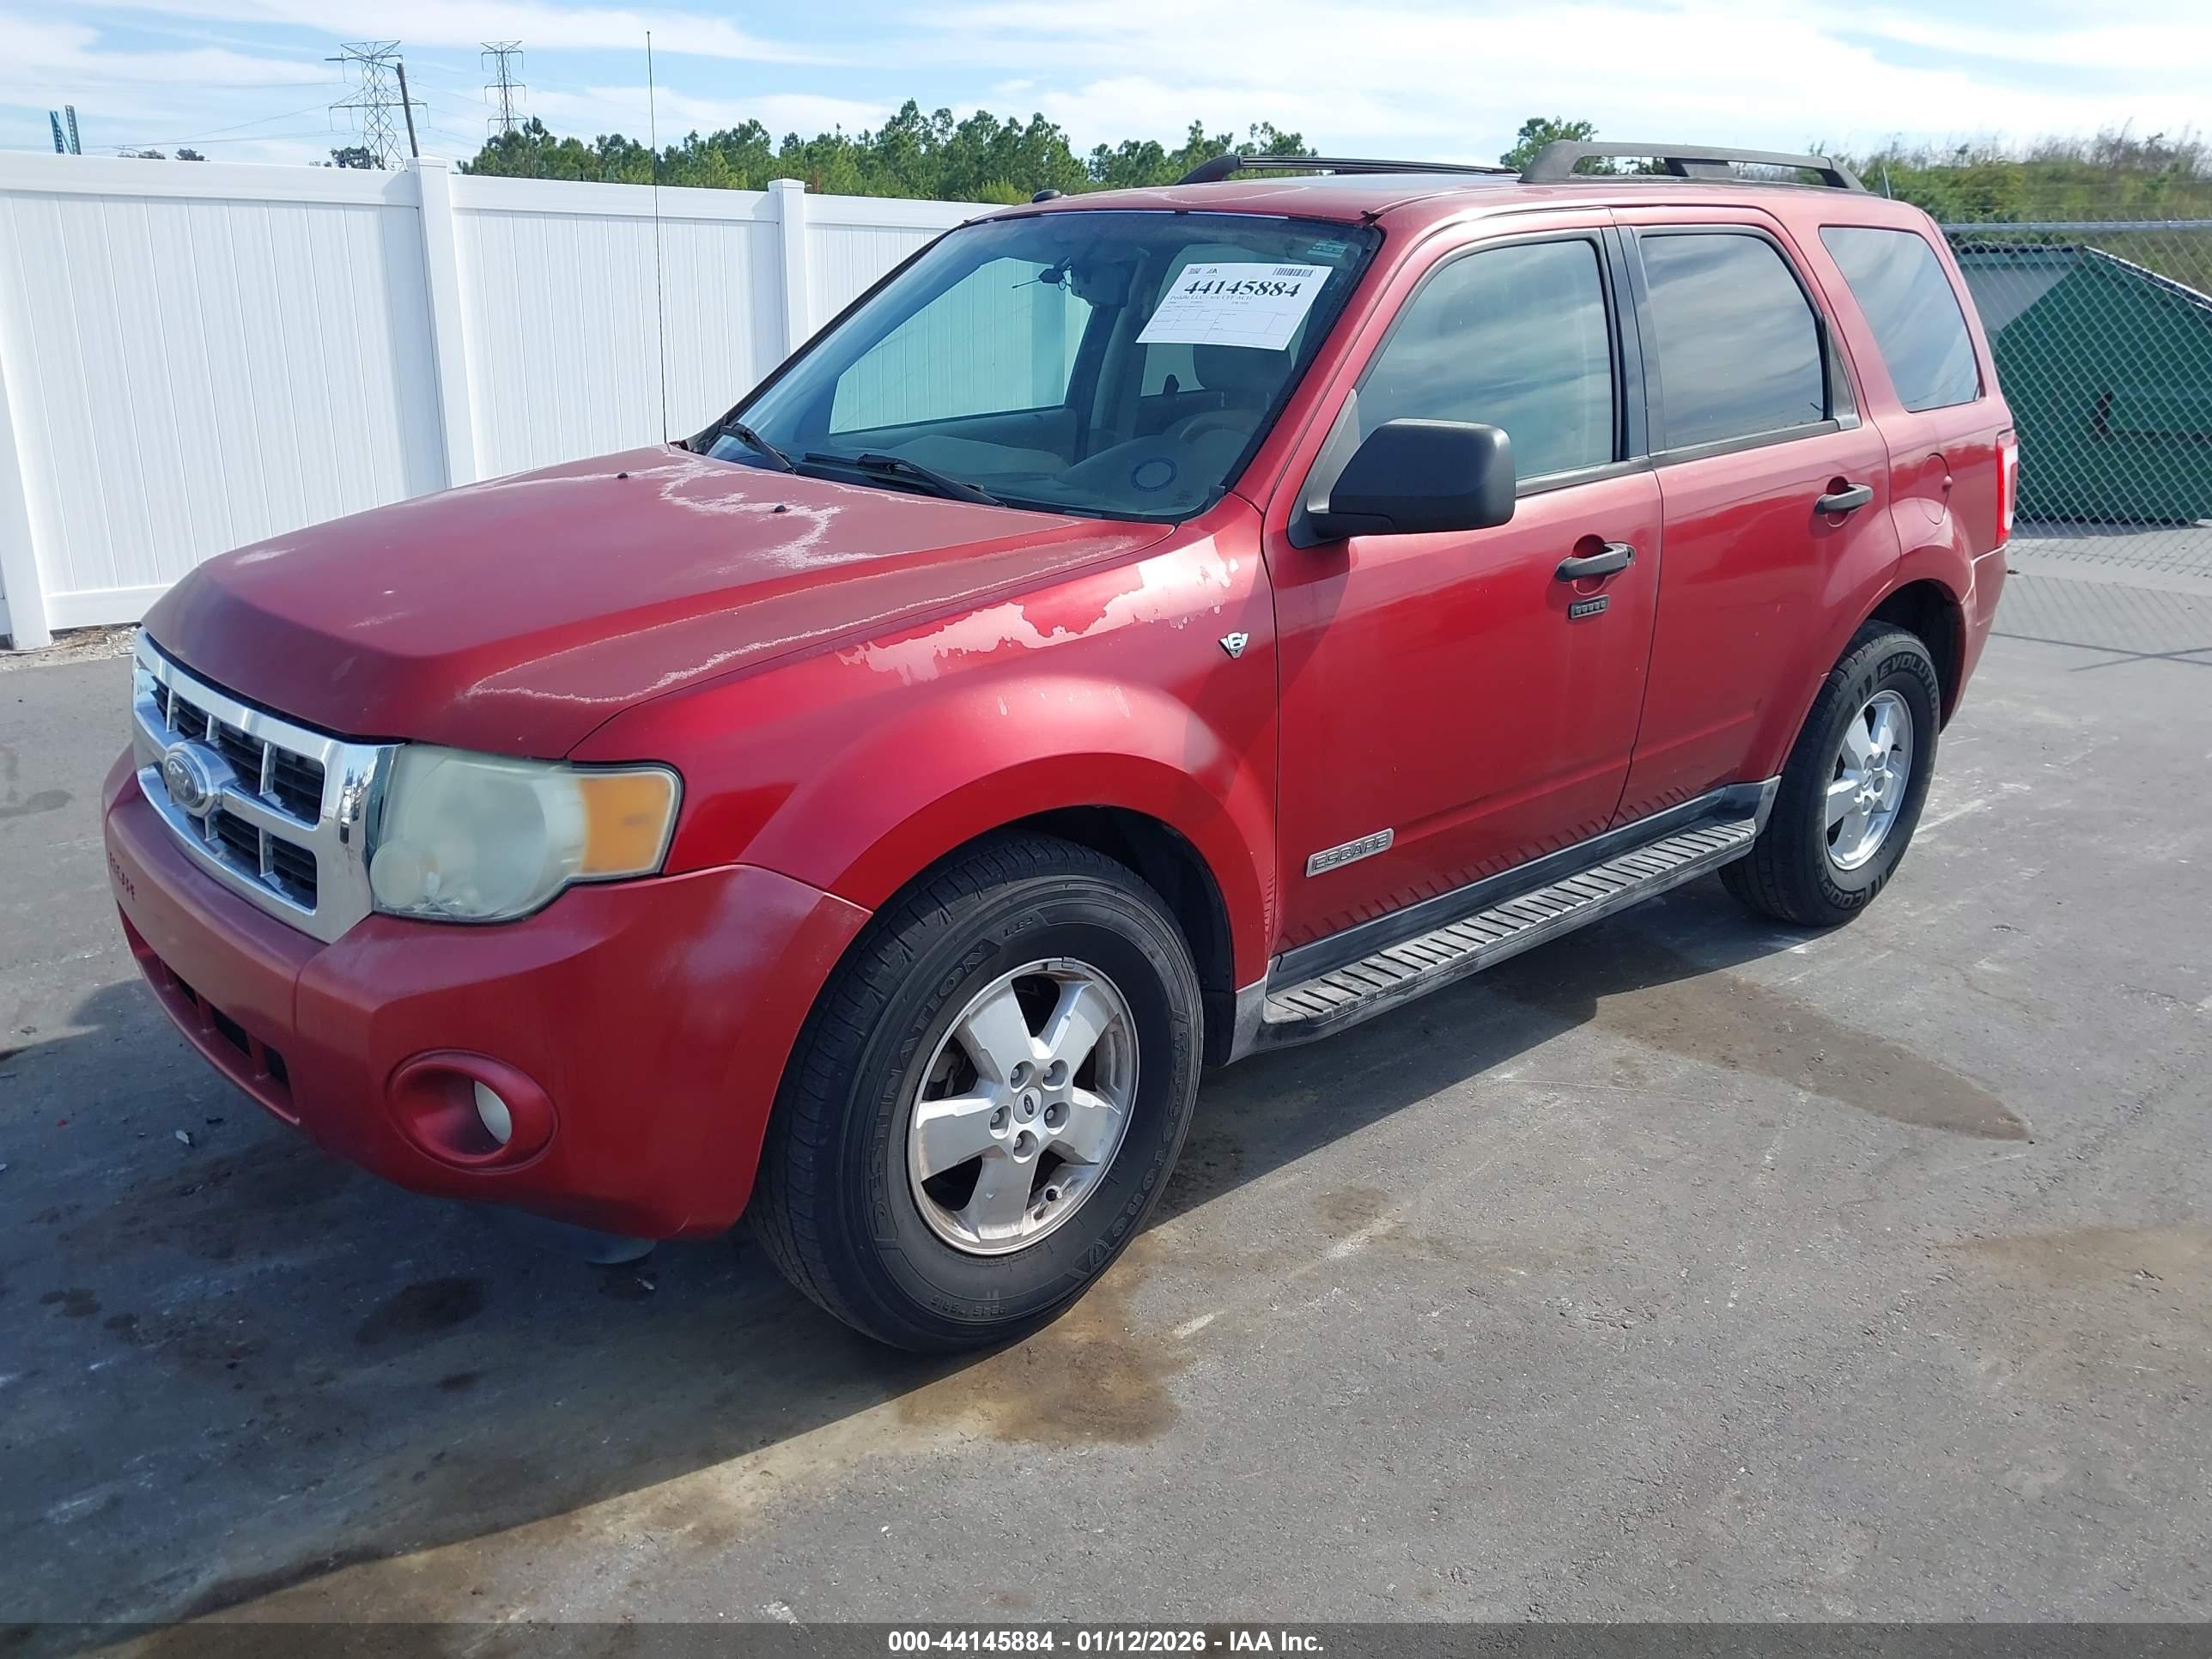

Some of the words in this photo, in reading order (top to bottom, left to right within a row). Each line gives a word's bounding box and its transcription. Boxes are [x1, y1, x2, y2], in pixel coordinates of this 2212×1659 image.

[1183, 279, 1303, 297] 44145884
[1219, 632, 1249, 659] V6
[1314, 833, 1389, 871] ESCAPE
[870, 944, 986, 1233] DESTINATION
